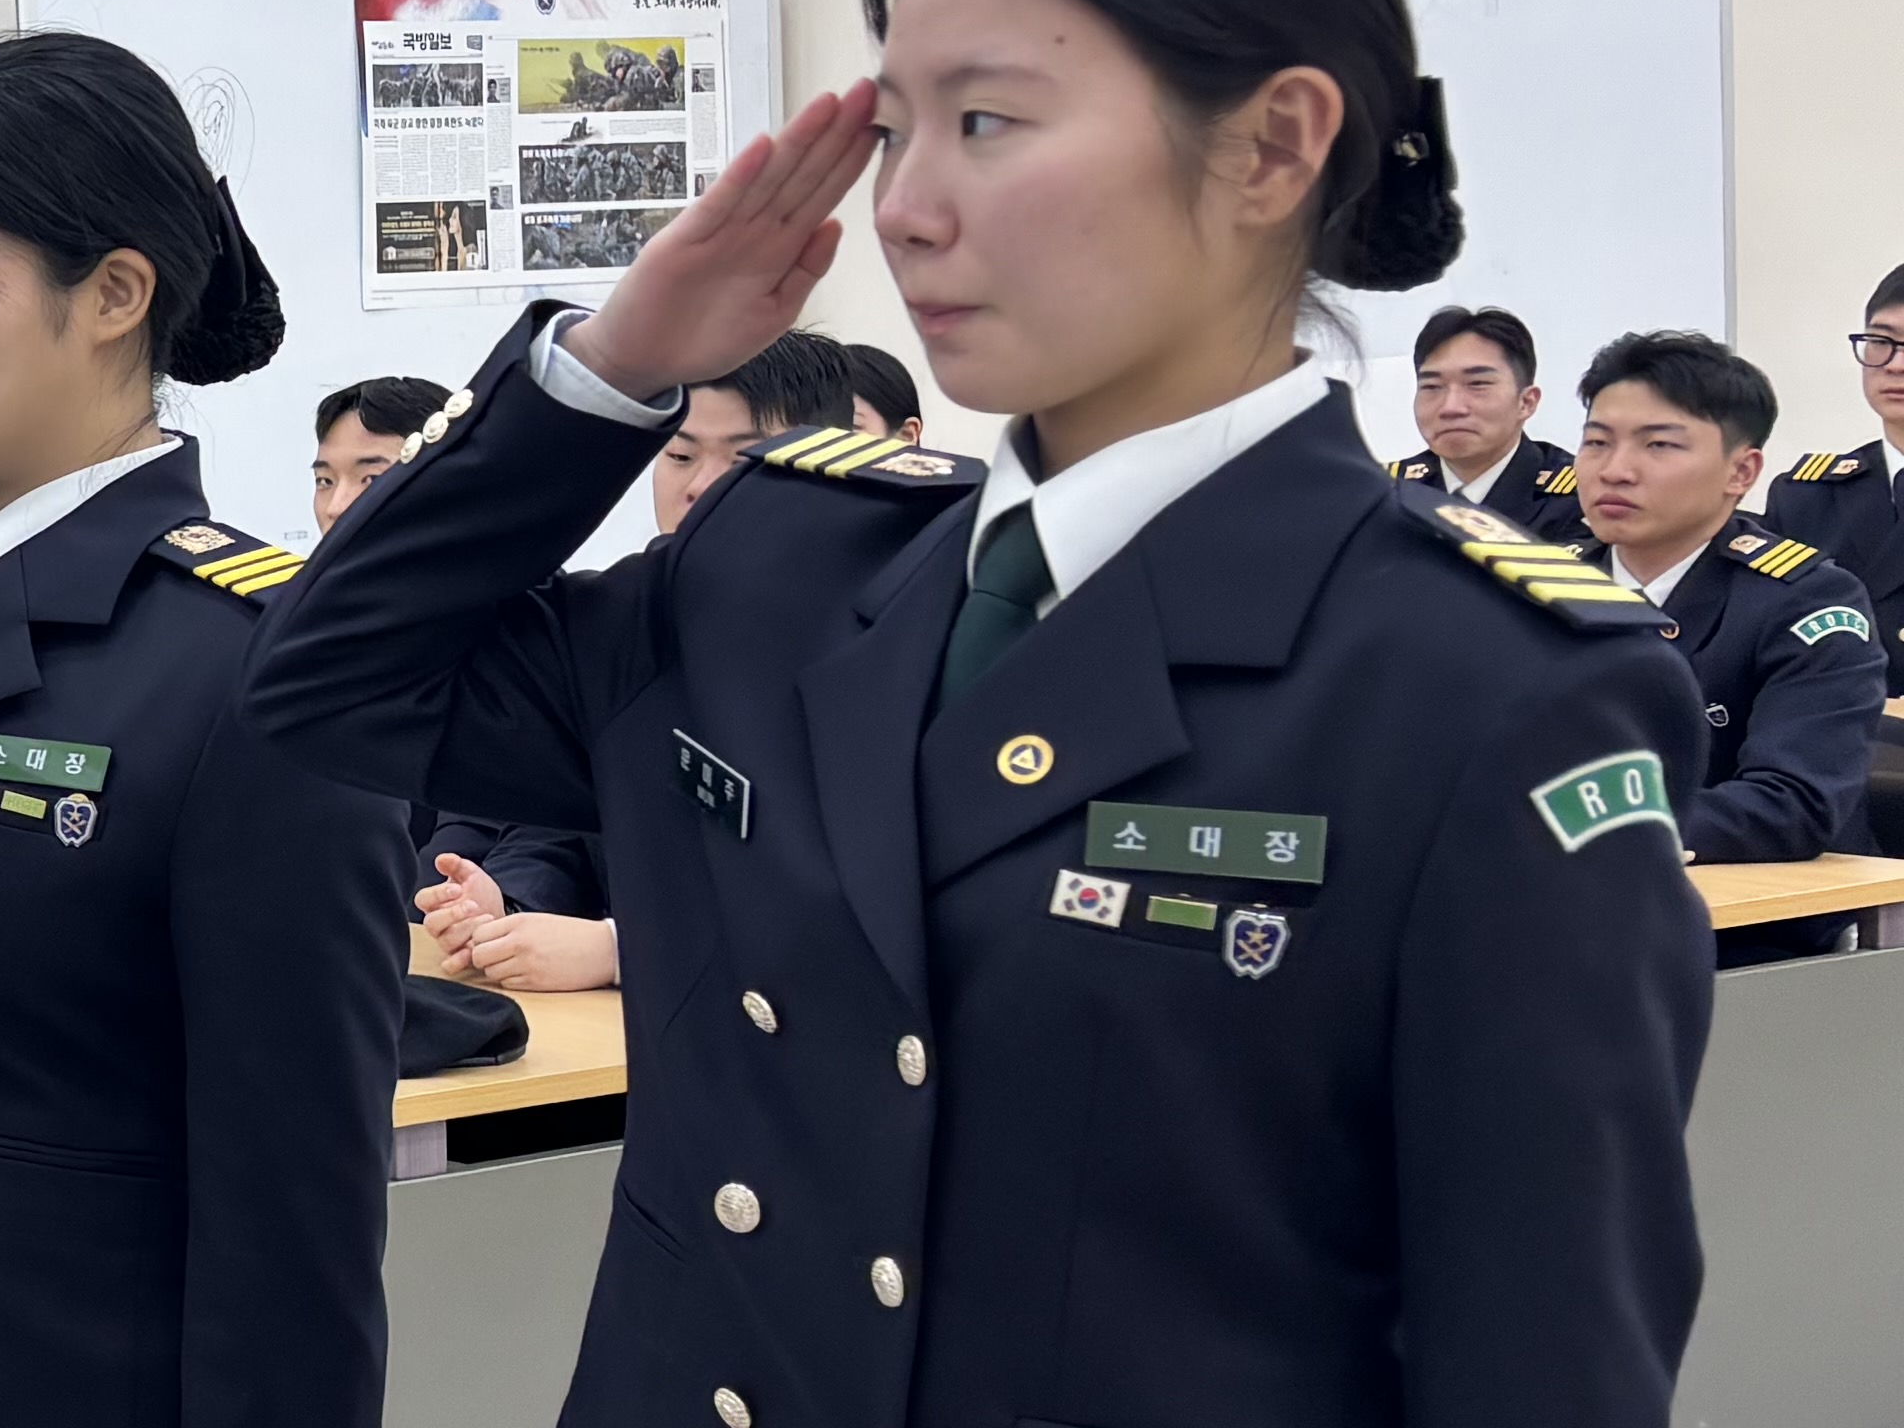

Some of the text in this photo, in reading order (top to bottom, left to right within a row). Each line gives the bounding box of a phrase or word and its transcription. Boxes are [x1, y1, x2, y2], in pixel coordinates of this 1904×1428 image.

[403, 32, 452, 51] 국방일보
[1808, 612, 1865, 634] ROTC
[1112, 822, 1300, 863] 소대장
